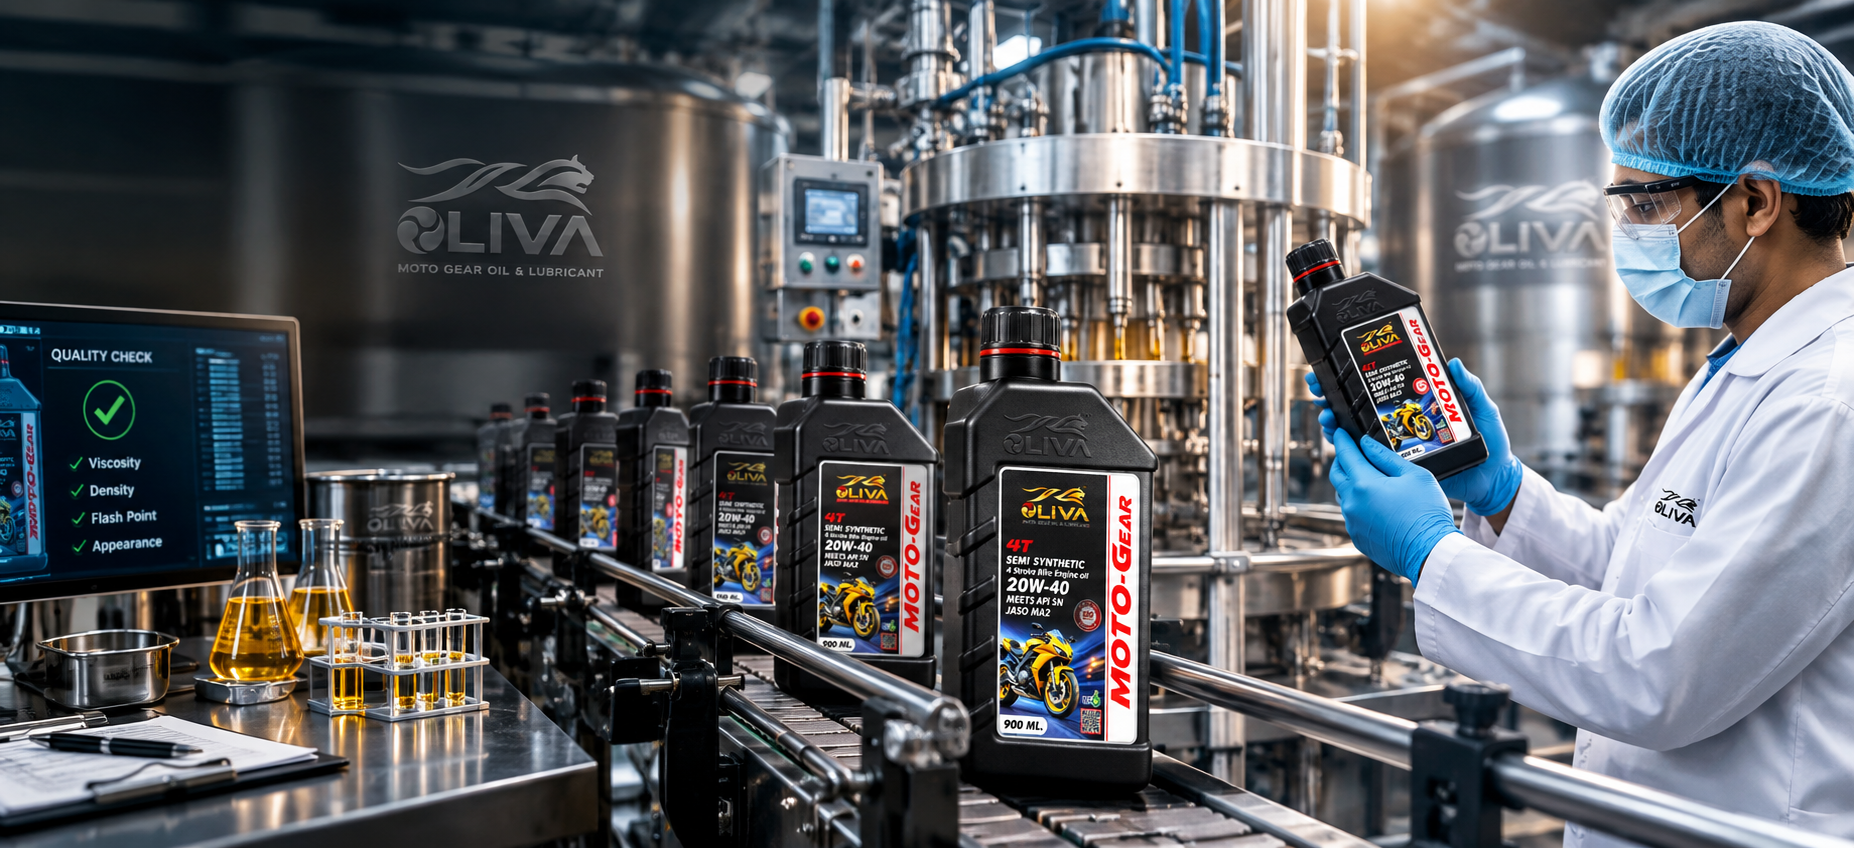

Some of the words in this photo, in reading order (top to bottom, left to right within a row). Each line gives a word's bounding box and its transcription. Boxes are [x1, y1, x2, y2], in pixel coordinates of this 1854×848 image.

[397, 206, 603, 257] OLIVA
[1454, 221, 1610, 258] OLIVA
[398, 263, 439, 274] MOTO
[443, 264, 482, 275] GEAR
[487, 265, 510, 276] OIL
[515, 267, 523, 276] &
[529, 266, 604, 278] LUBRICANT
[1361, 334, 1400, 352] OLIVA
[51, 348, 107, 363] QUALITY
[111, 351, 153, 364] CHECK
[822, 437, 890, 455] OLIVA
[1003, 433, 1092, 458] OLIVA
[89, 456, 141, 471] Viscosity
[90, 484, 135, 499] Density
[836, 486, 888, 500] OLIVA
[91, 511, 123, 525] Flash
[127, 510, 157, 523] Point
[824, 512, 846, 523] 4T
[1021, 502, 1089, 522] OLIVA
[1654, 500, 1697, 529] OLIVA
[92, 537, 163, 553] Appearance
[1006, 538, 1034, 553] 4T
[905, 481, 920, 633] MOTO-GEAR
[1006, 555, 1030, 565] SEMI
[1033, 557, 1085, 569] SYNTHETIC
[1006, 577, 1070, 596] 20W-40
[1006, 595, 1035, 605] MEETS
[1052, 598, 1064, 607] SN
[1111, 496, 1132, 709] MOTO-GEAR
[1005, 606, 1029, 616] JASO
[1031, 608, 1051, 618] MA2
[1004, 719, 1024, 730] 900
[1026, 720, 1043, 731] ML.
